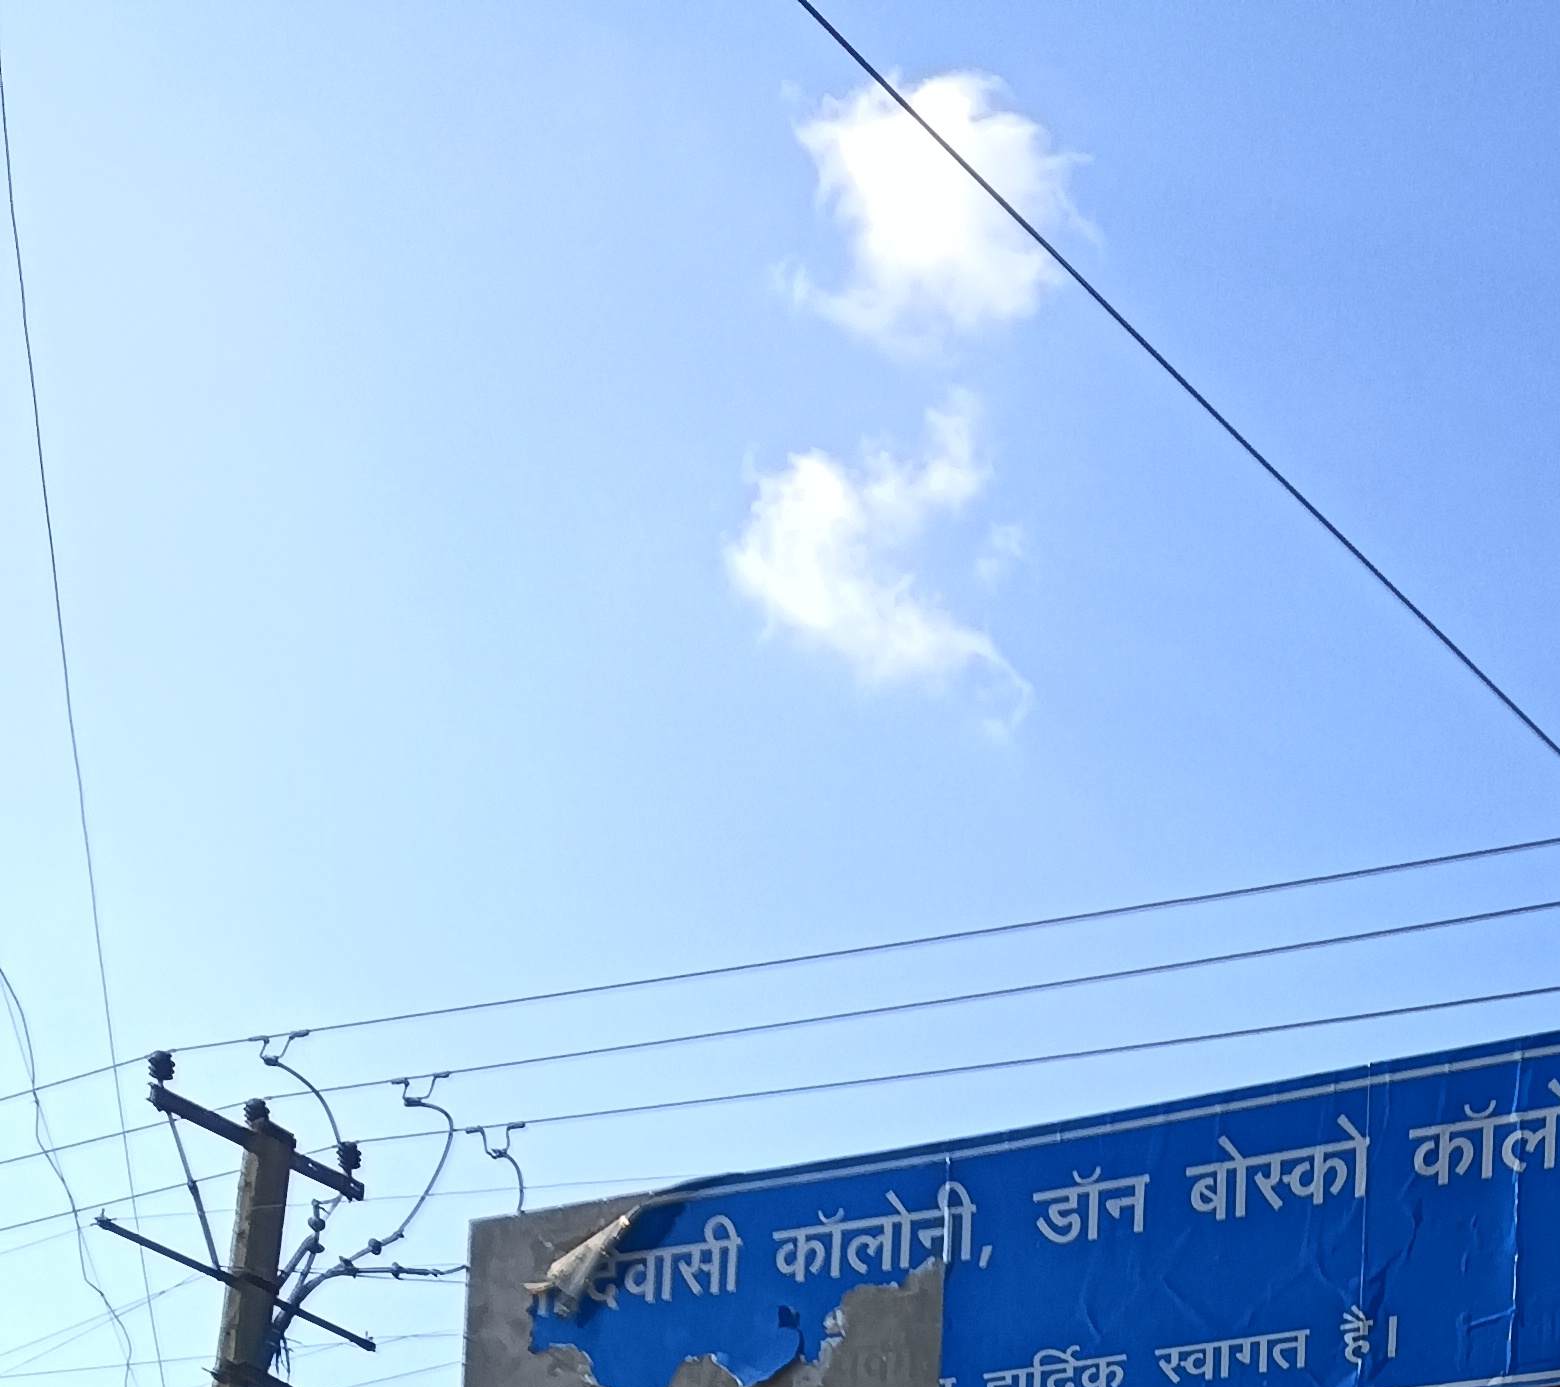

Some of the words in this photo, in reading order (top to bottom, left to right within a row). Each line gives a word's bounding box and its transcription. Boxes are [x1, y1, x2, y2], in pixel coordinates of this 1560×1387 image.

[772, 1180, 994, 1284] कॉलोनी,
[1033, 1166, 1150, 1244] डॉन
[1186, 1114, 1370, 1222] बोस्को
[1154, 1328, 1310, 1384] स्वागत
